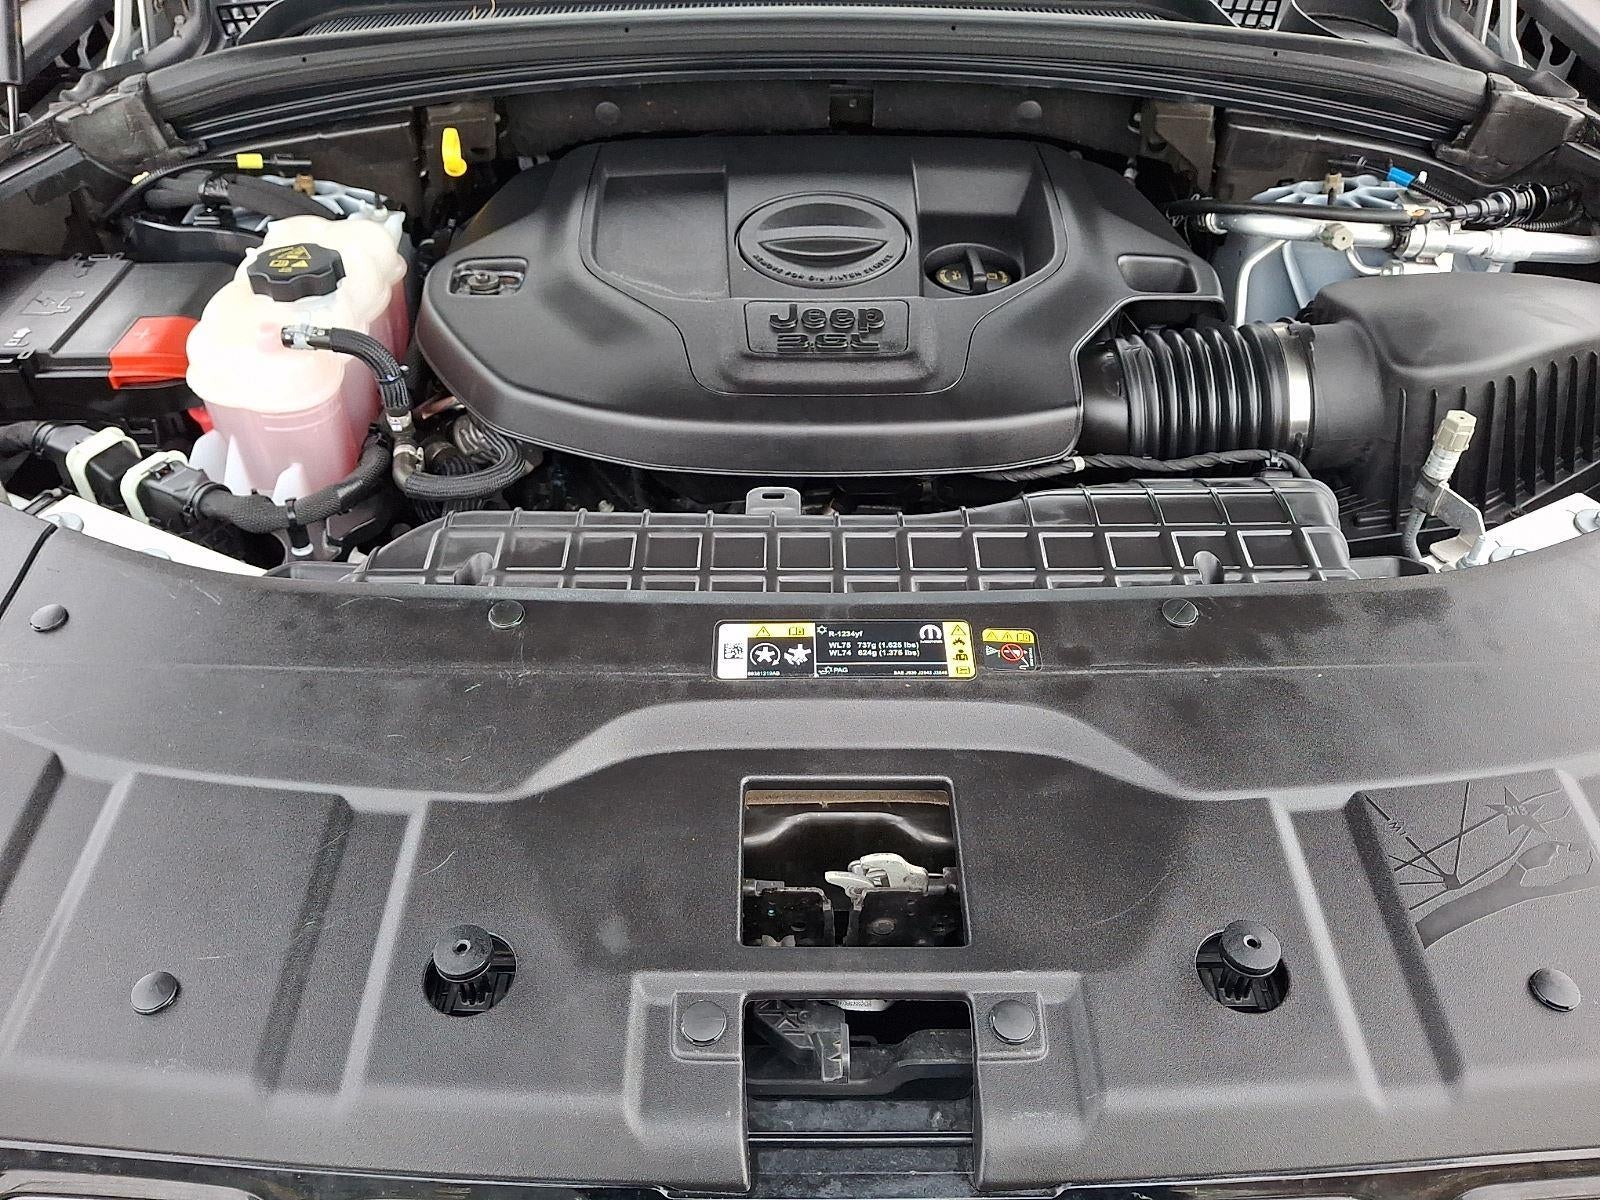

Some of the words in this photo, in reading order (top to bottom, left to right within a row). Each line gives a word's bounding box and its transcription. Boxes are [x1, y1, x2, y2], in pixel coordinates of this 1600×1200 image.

[769, 303, 886, 333] Jeep
[776, 332, 881, 352] 3.6L
[828, 630, 864, 638] R-1234yf
[879, 641, 903, 649] (1.625
[904, 641, 920, 649] lbs)
[904, 649, 920, 657] lbs)
